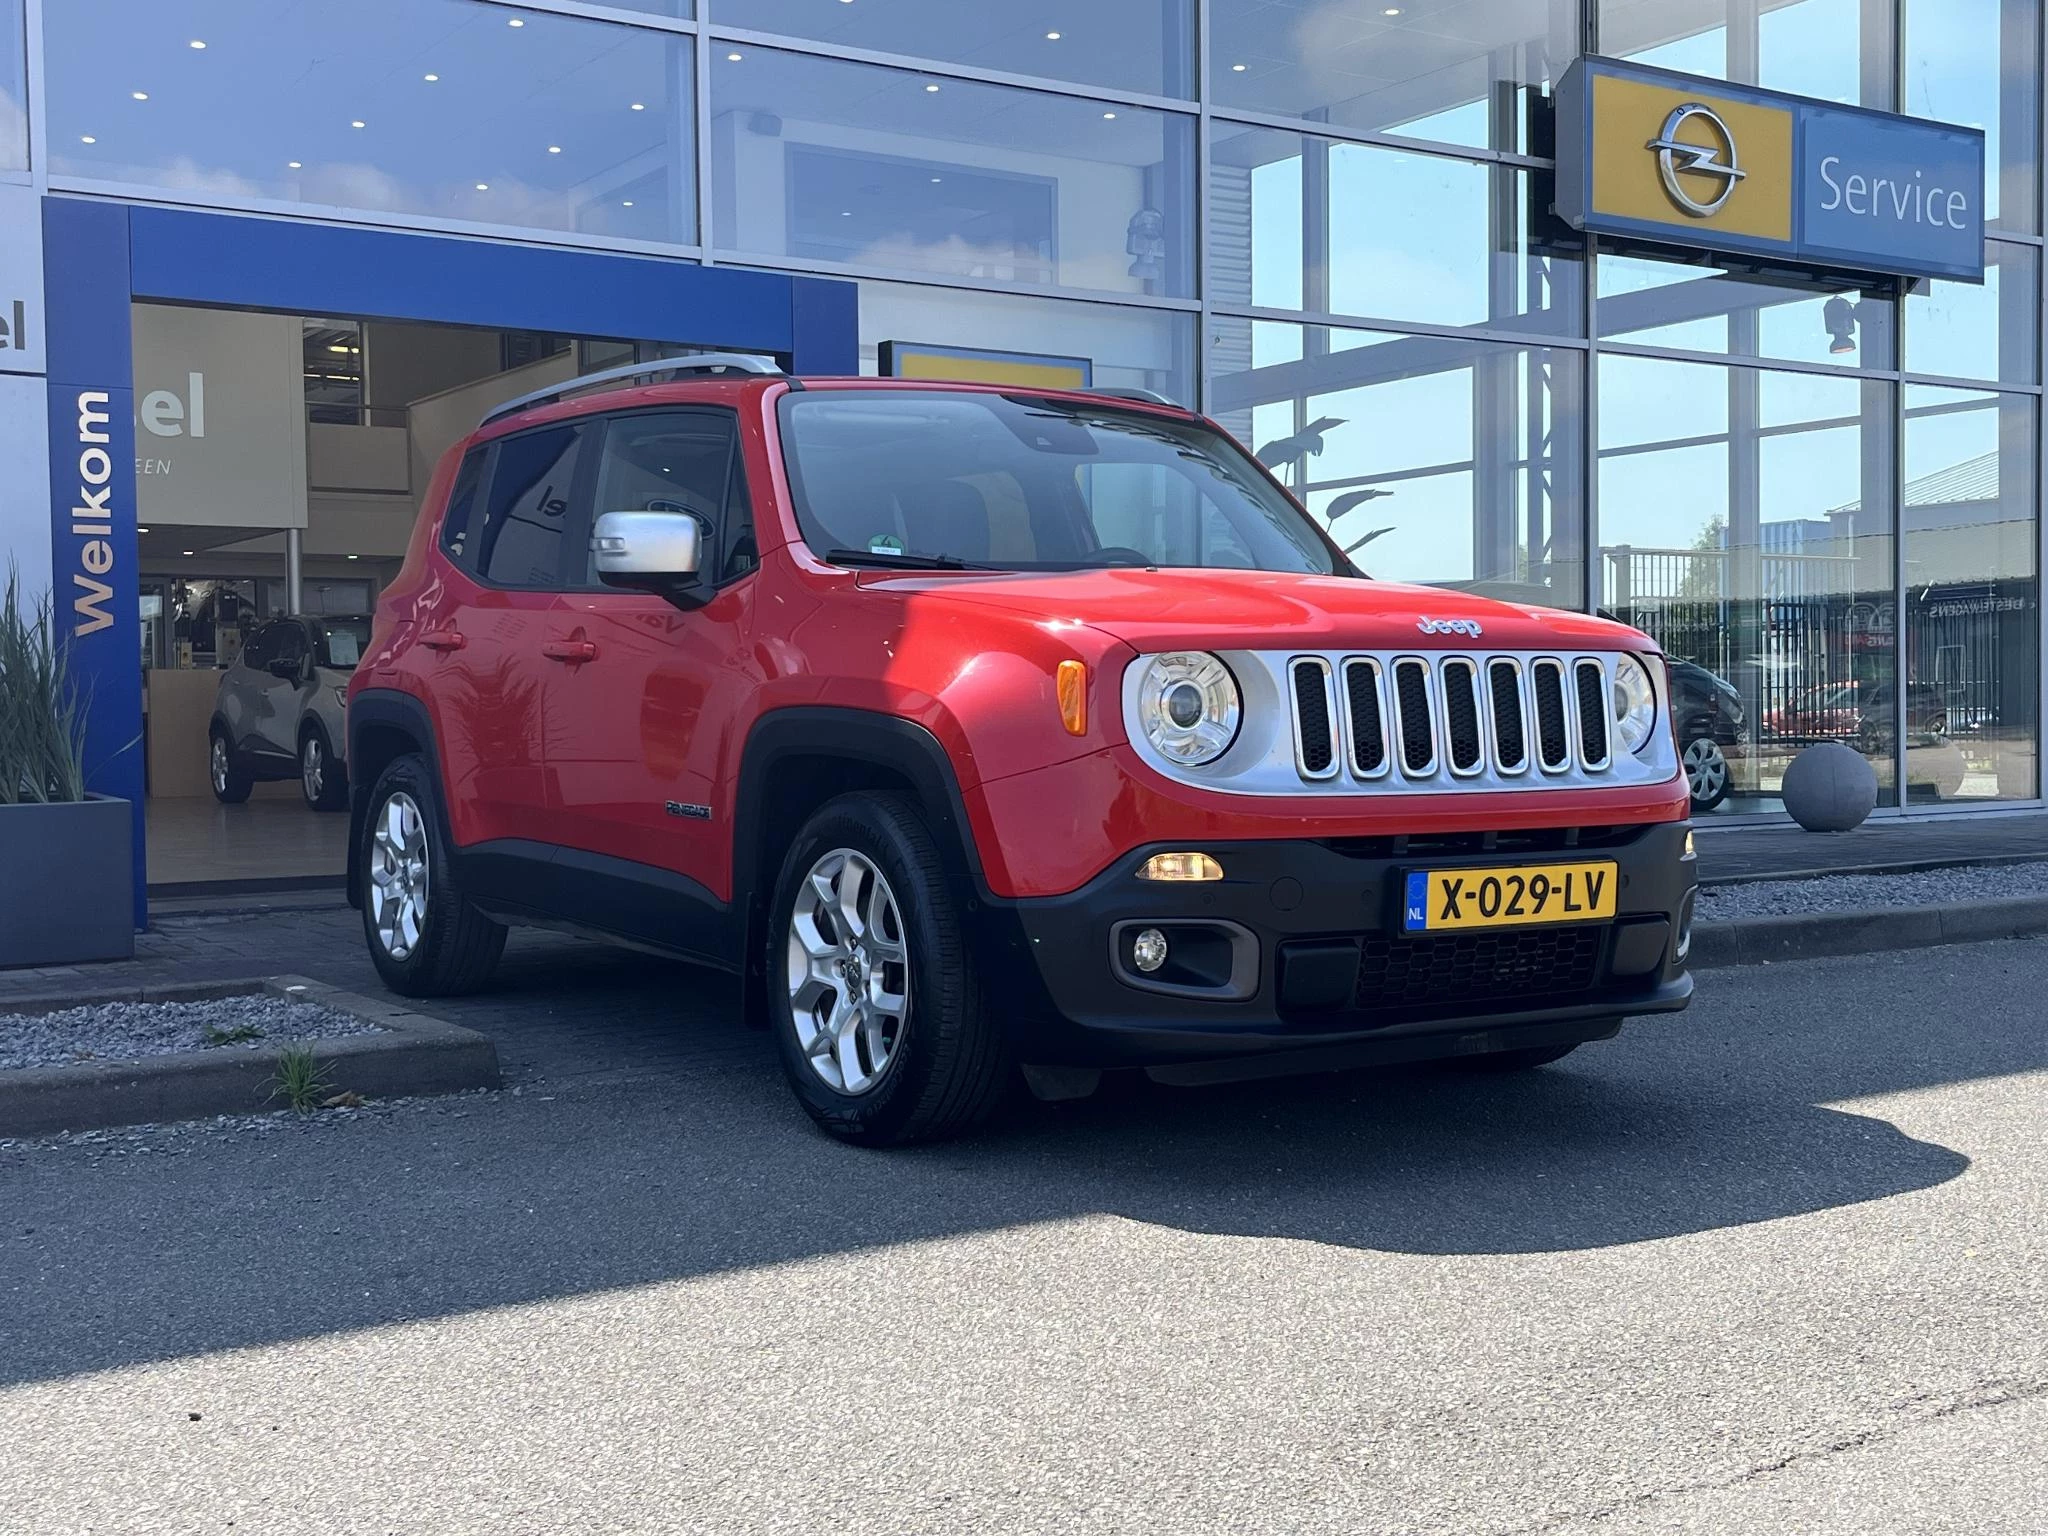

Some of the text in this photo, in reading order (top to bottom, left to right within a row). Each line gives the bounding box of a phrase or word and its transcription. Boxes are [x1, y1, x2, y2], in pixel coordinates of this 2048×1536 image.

[1820, 157, 1967, 230] Service
[134, 372, 204, 437] el
[72, 391, 114, 637] Welkom
[1416, 616, 1483, 638] Jeep
[1408, 907, 1424, 920] NL
[1440, 870, 1605, 920] X-029-LV
